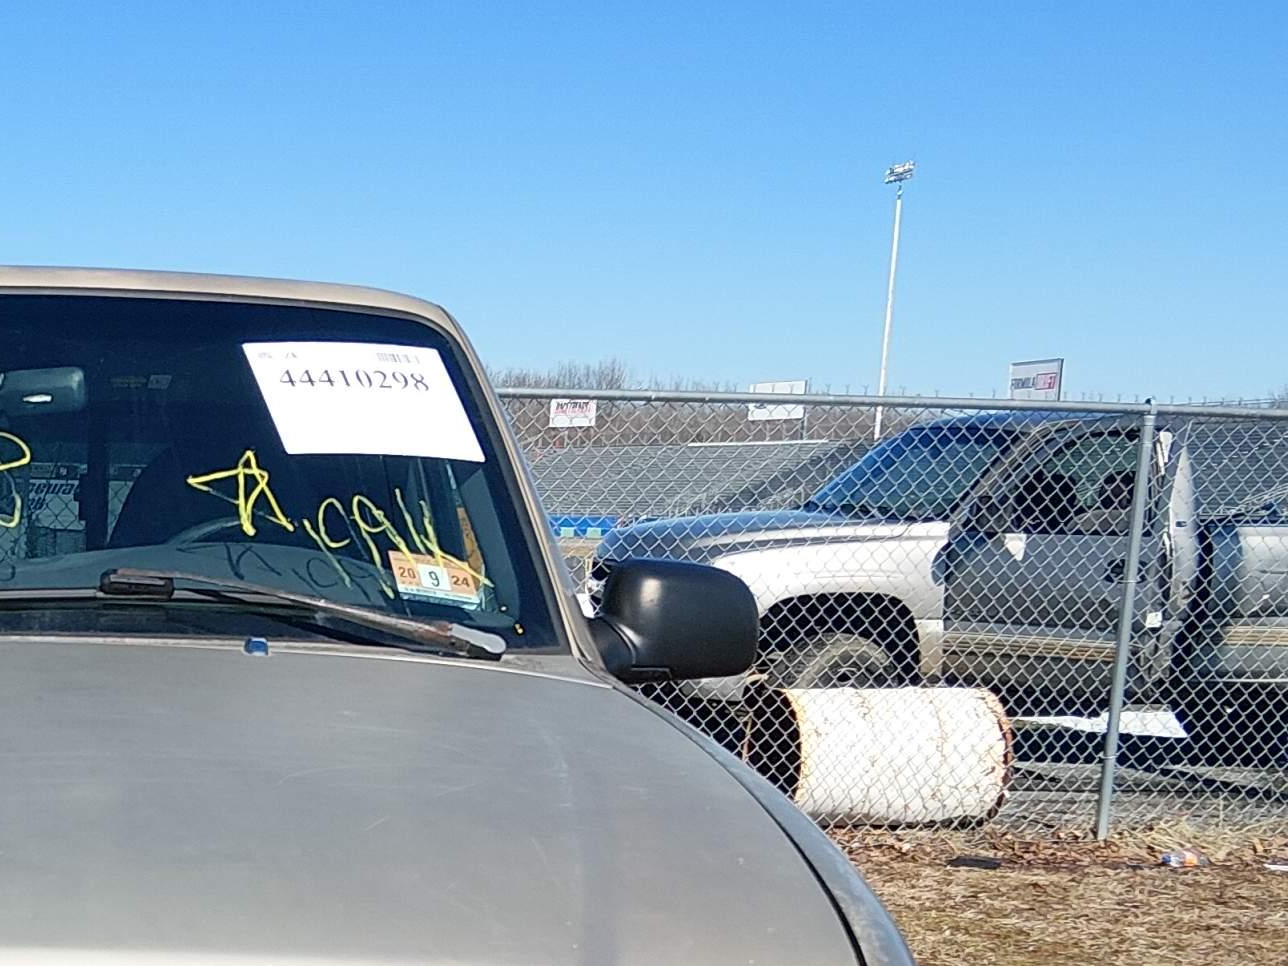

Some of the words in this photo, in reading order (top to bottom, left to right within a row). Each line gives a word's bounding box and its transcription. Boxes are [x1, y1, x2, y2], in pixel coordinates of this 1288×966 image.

[279, 368, 430, 392] 44410298
[398, 566, 417, 580] 20
[428, 571, 440, 588] 9
[451, 575, 471, 588] 24
